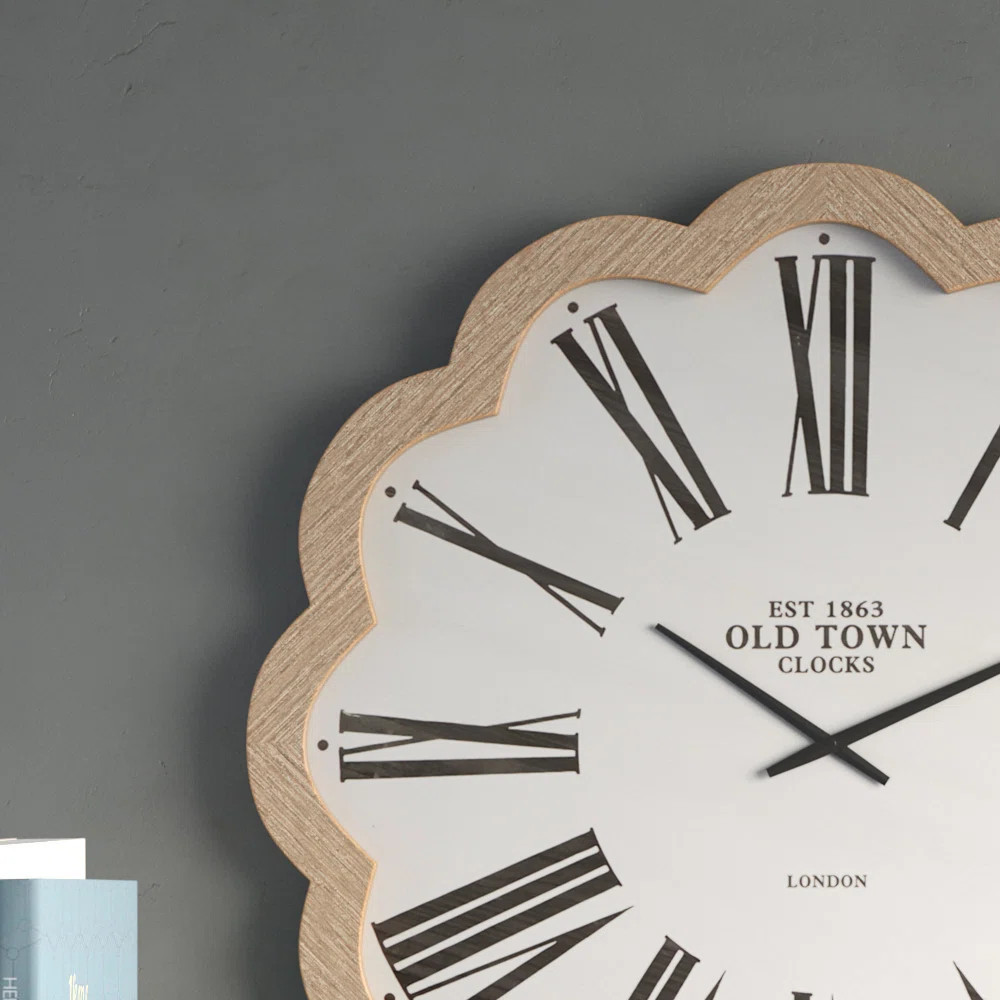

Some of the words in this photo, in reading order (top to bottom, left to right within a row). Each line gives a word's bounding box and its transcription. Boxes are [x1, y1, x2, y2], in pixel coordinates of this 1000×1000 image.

[775, 256, 877, 497] XII
[550, 303, 731, 544] XI
[393, 480, 624, 637] X
[768, 600, 815, 619] EST
[826, 600, 885, 619] 1863
[725, 624, 801, 650] OLD
[814, 624, 928, 650] TOWN
[777, 655, 876, 674] CLOCKS
[339, 709, 581, 782] IX
[786, 874, 868, 888] LONDON
